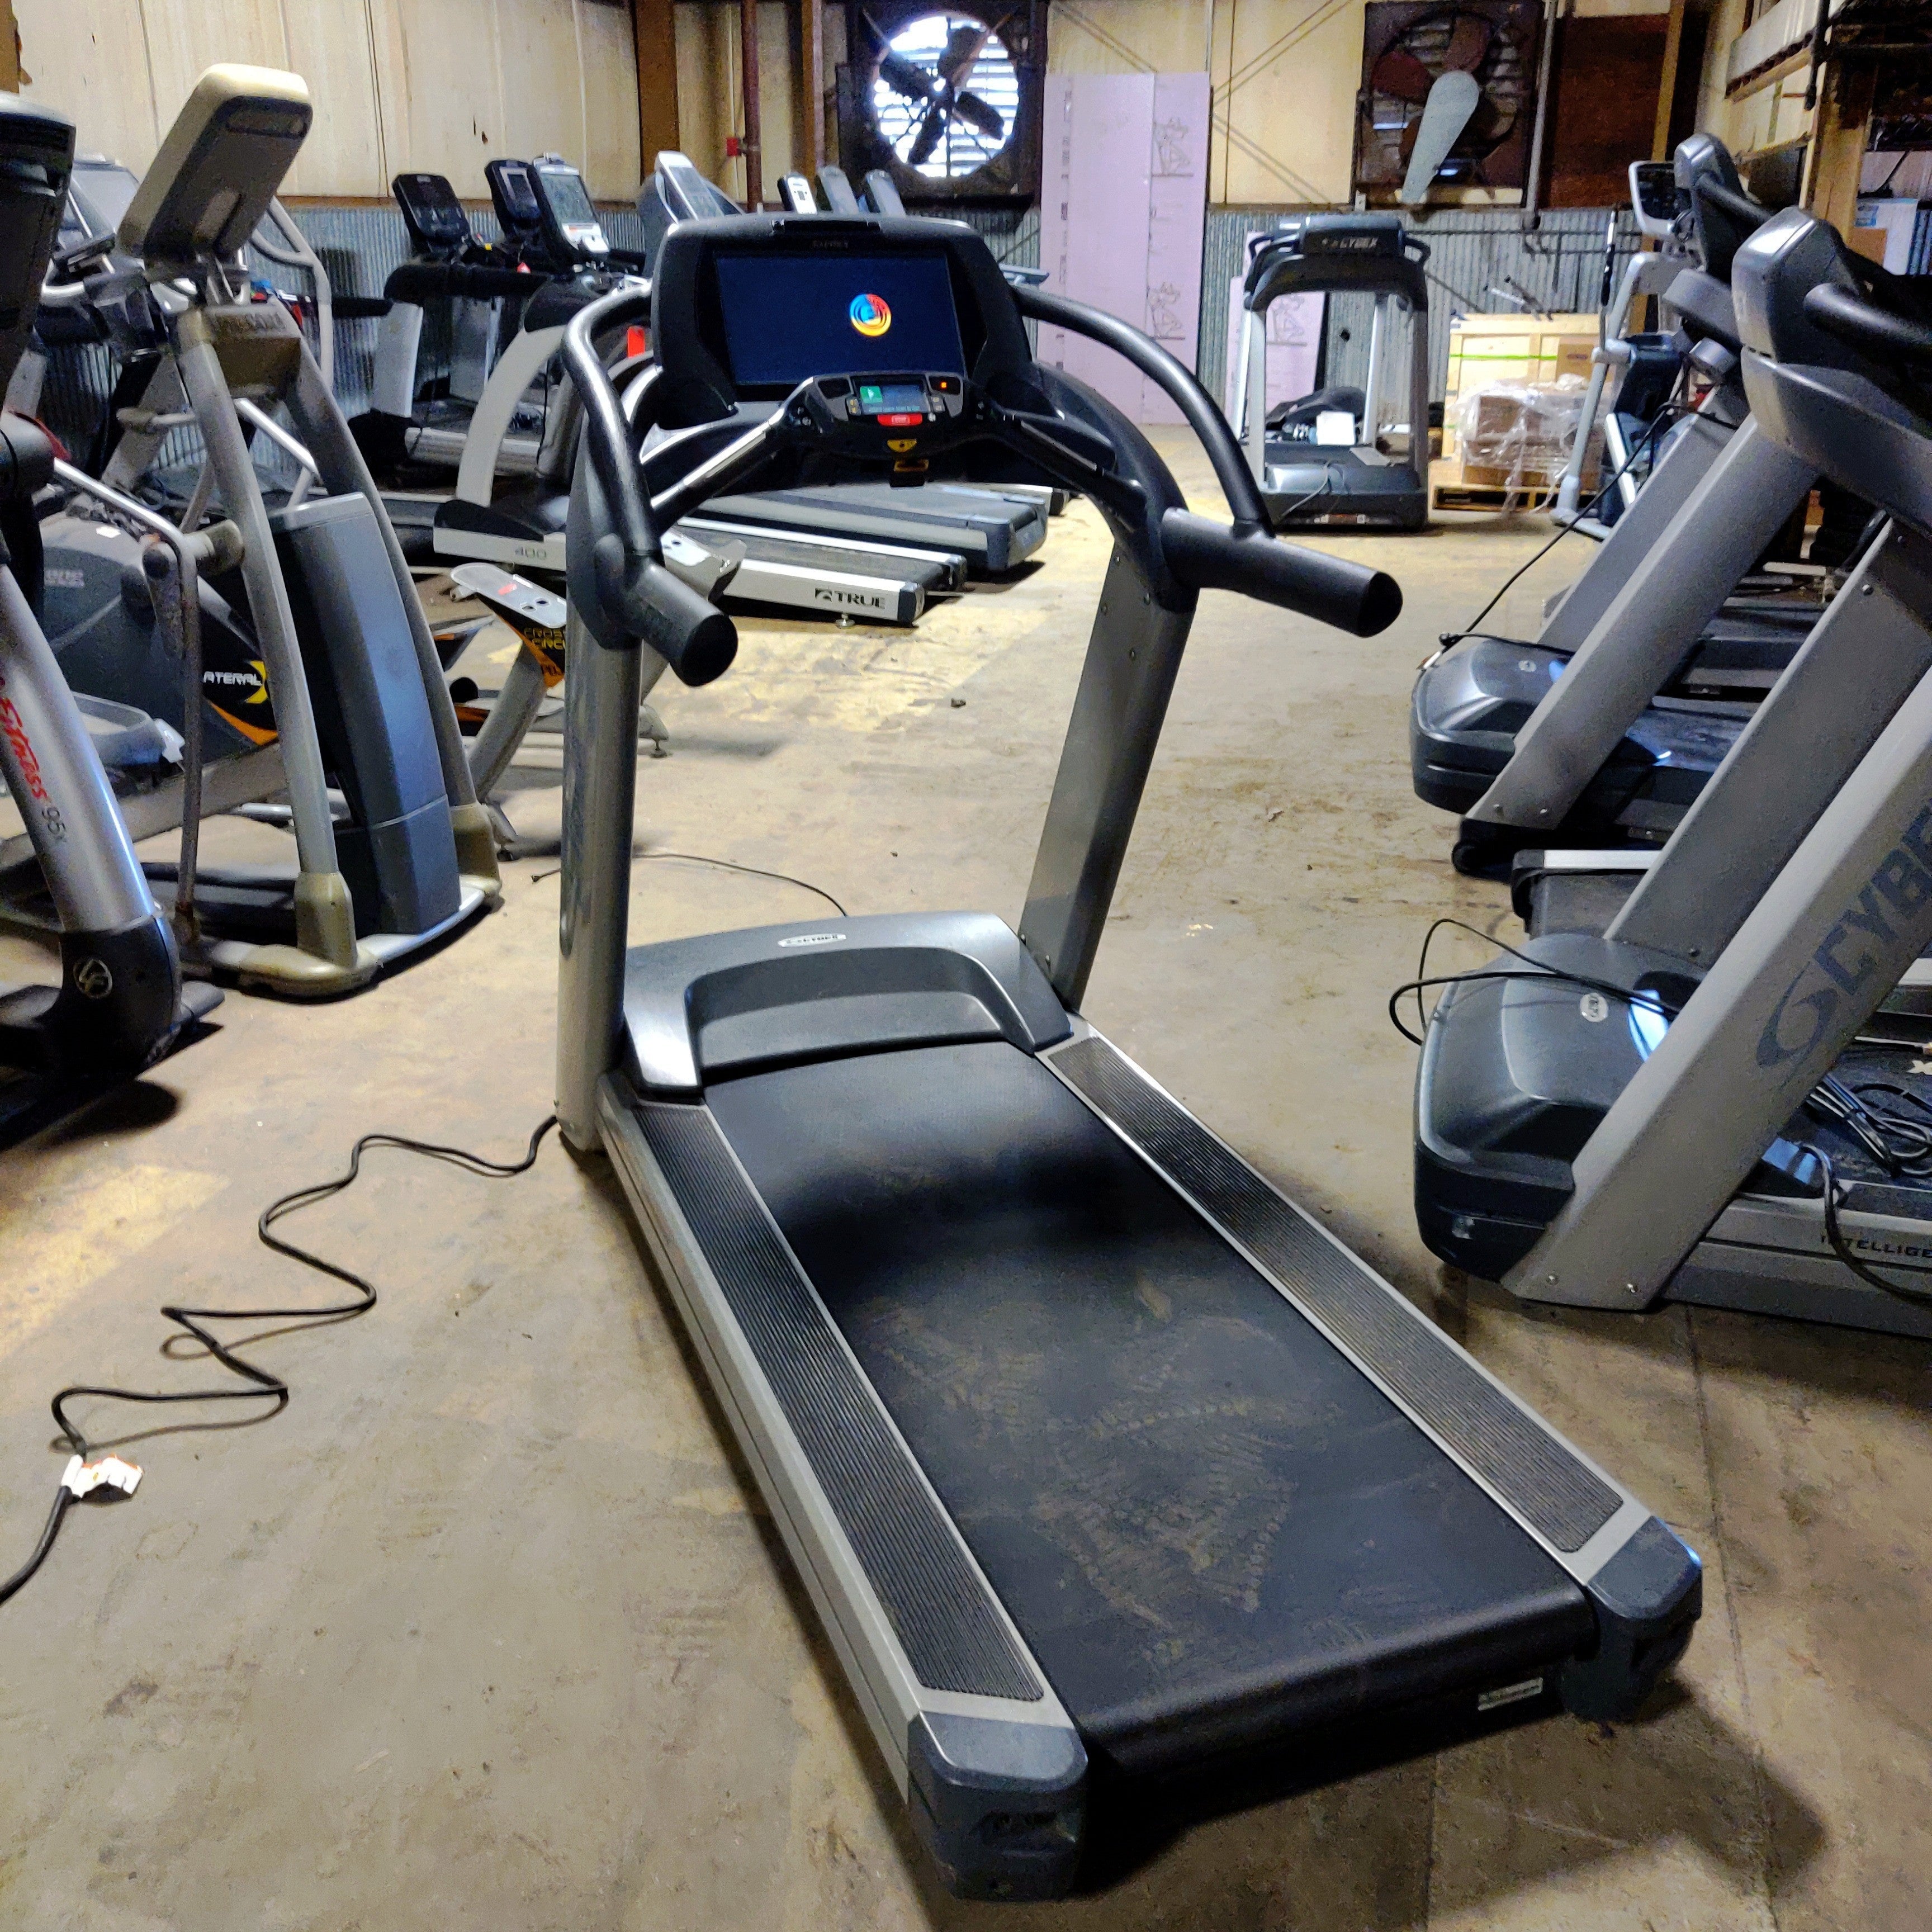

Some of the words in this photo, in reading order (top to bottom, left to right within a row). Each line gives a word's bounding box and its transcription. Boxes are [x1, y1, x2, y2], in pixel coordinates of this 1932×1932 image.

[834, 590, 886, 610] TRUE
[203, 671, 263, 686] ATERAL
[1813, 796, 1932, 996] CYBE
[1821, 1232, 1932, 1258] ITELLIGE
